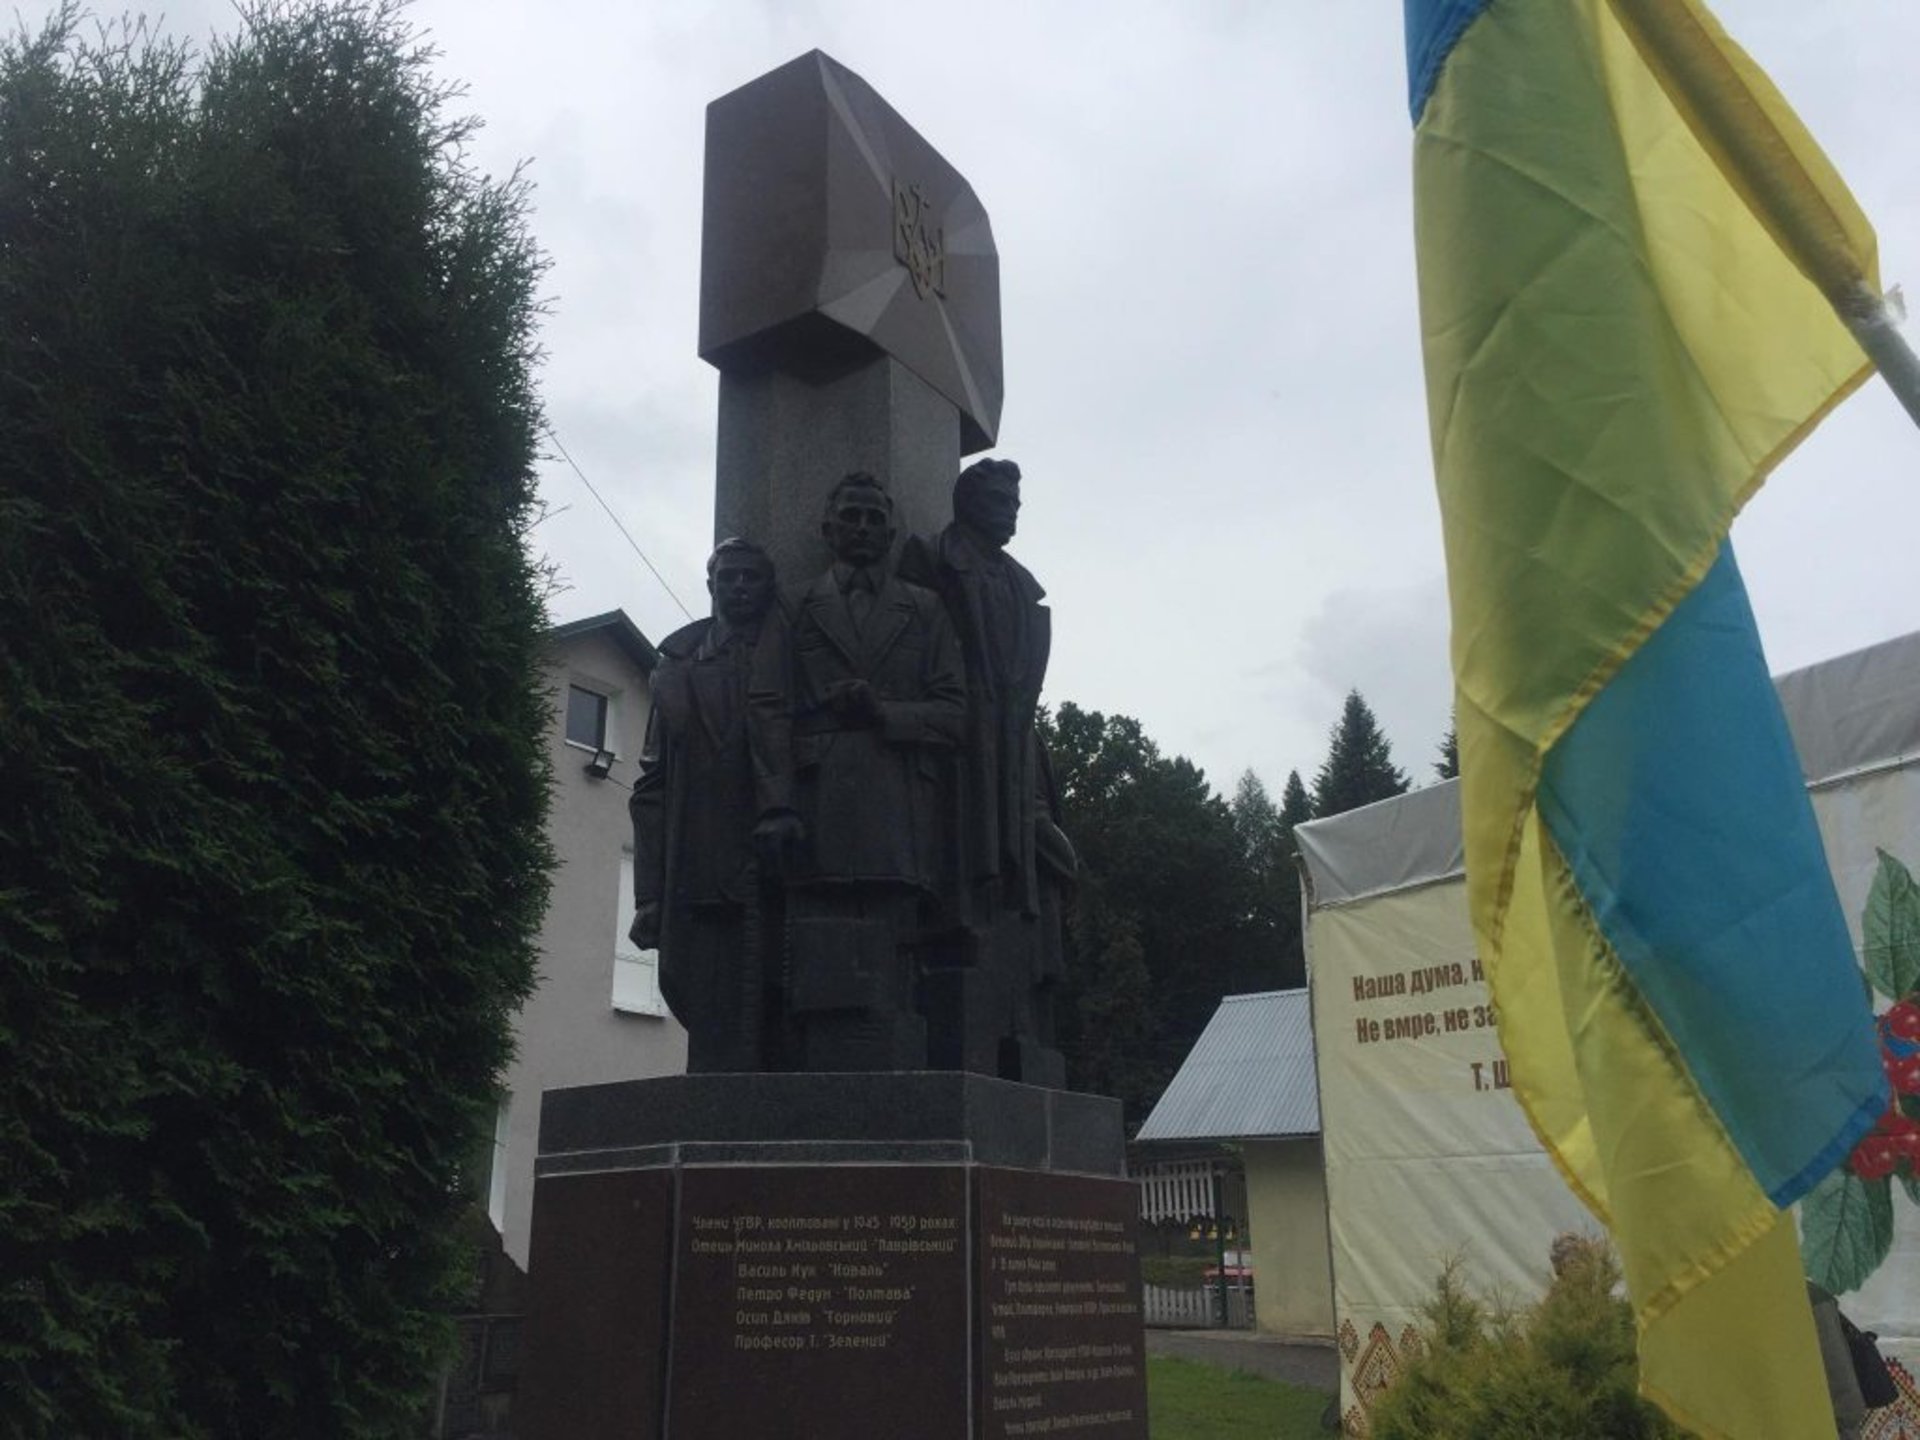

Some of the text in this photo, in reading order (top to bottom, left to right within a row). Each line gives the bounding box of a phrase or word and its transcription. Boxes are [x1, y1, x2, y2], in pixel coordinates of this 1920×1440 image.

[1352, 972, 1406, 1002] Наша
[1410, 962, 1468, 996] дума,
[1356, 1017, 1380, 1044] Не
[1383, 1010, 1441, 1040] вмре,
[1443, 1007, 1469, 1032] не
[1470, 1062, 1489, 1092] Т.
